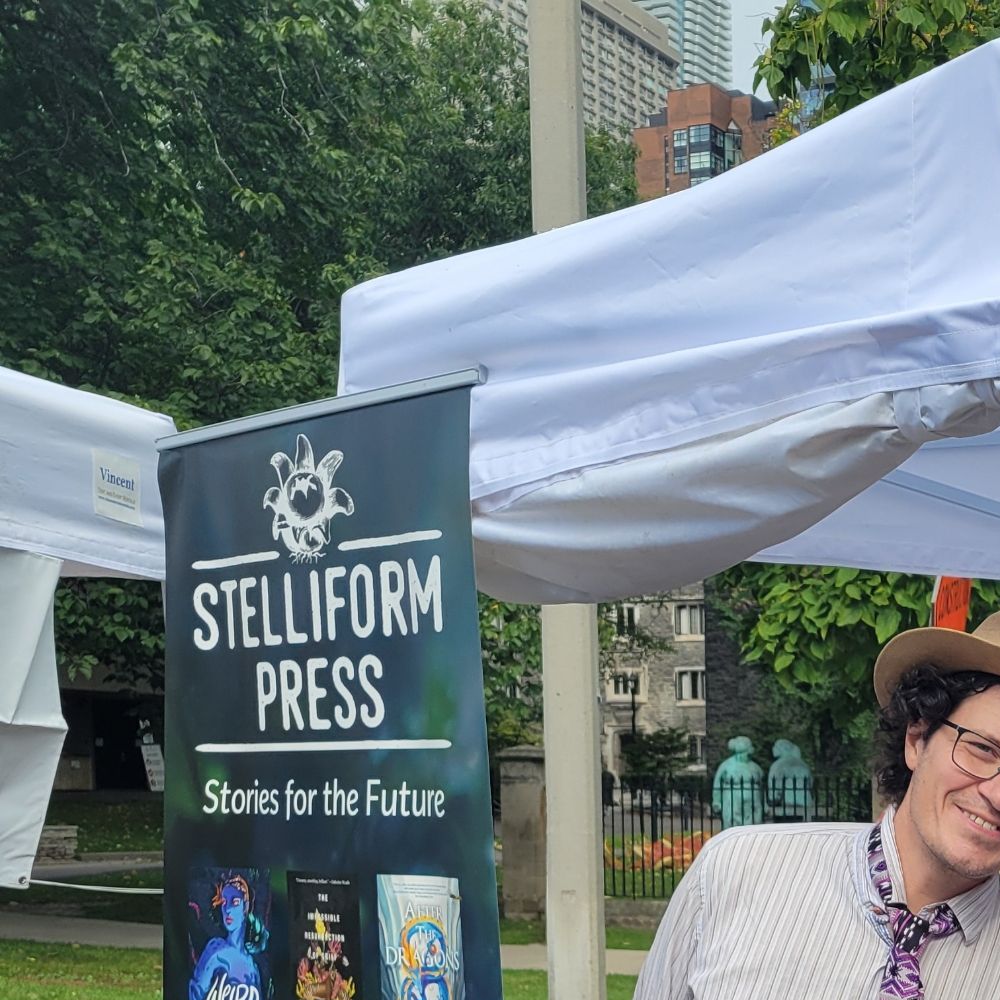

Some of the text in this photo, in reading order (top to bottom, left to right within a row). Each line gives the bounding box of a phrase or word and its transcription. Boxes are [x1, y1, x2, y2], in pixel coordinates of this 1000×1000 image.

[100, 466, 135, 491] Vincent
[193, 555, 443, 650] STELLIFORM
[256, 654, 385, 731] PRESS
[202, 778, 445, 820] Stories for the Future
